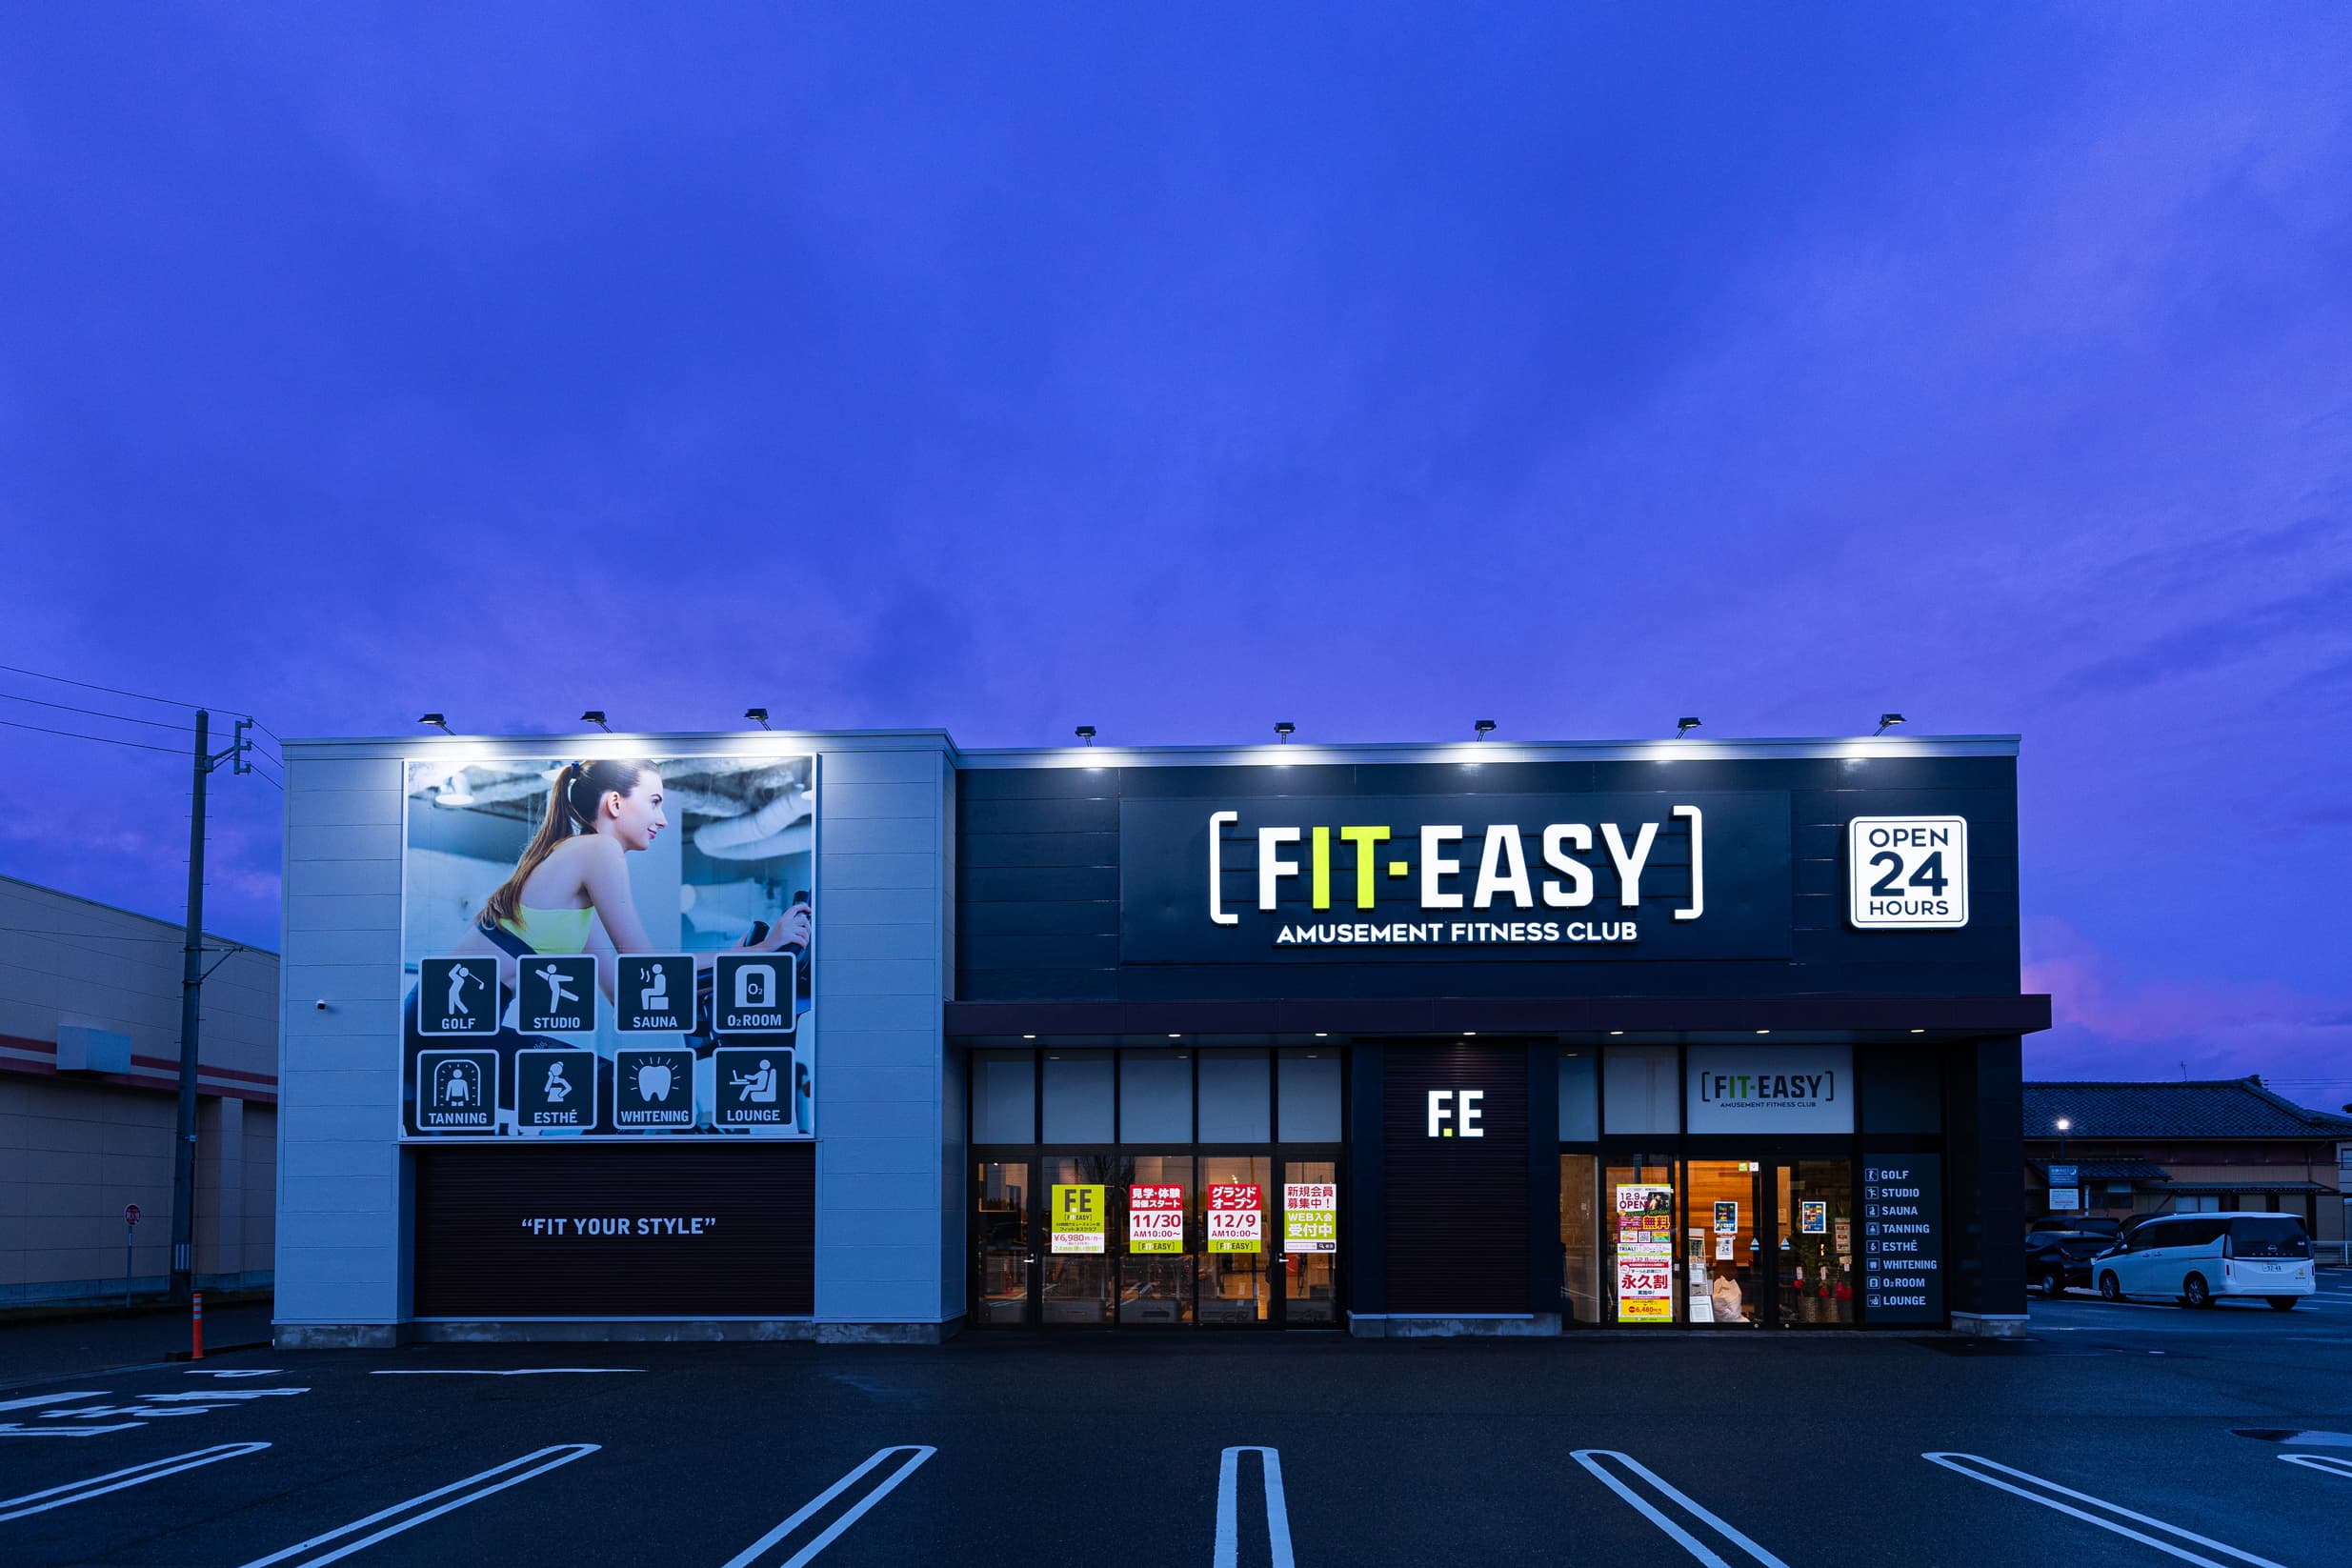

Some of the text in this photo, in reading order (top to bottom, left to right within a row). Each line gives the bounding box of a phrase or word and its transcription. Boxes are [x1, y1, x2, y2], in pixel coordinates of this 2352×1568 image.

[1869, 828, 1948, 848] OPEN
[1869, 851, 1948, 896] 24
[1870, 900, 1949, 915] HOURS
[1277, 921, 1638, 944] AMUSEMENT FITNESS CLUB
[441, 1017, 475, 1030] GOLF
[533, 1016, 580, 1029] STUDIO
[633, 1015, 677, 1028] SAUNA
[429, 1112, 487, 1124] TANNING
[533, 1109, 577, 1123] ESTHÉ
[621, 1110, 689, 1123] WHITENING
[727, 1109, 780, 1122] LOUNGE
[1880, 1170, 1909, 1180] GOLF
[1212, 1186, 1256, 1198] グランド
[1287, 1186, 1334, 1197] 新規会員
[1881, 1188, 1920, 1197] STUDIO
[1212, 1198, 1256, 1209] オープン
[1619, 1200, 1647, 1209] OPEN
[1288, 1213, 1333, 1222] WEB入会
[1881, 1206, 1919, 1216] SAUNA
[573, 1217, 631, 1236] YOUR
[1133, 1214, 1181, 1228] 11/30
[1214, 1214, 1256, 1228] 12/9
[1643, 1216, 1670, 1229] 無料
[1289, 1223, 1333, 1237] 受付中
[1882, 1224, 1930, 1234] TANNING
[1883, 1260, 1937, 1270] WHITENING
[1621, 1275, 1668, 1289] 永久割
[1883, 1296, 1926, 1306] LOUNGE
